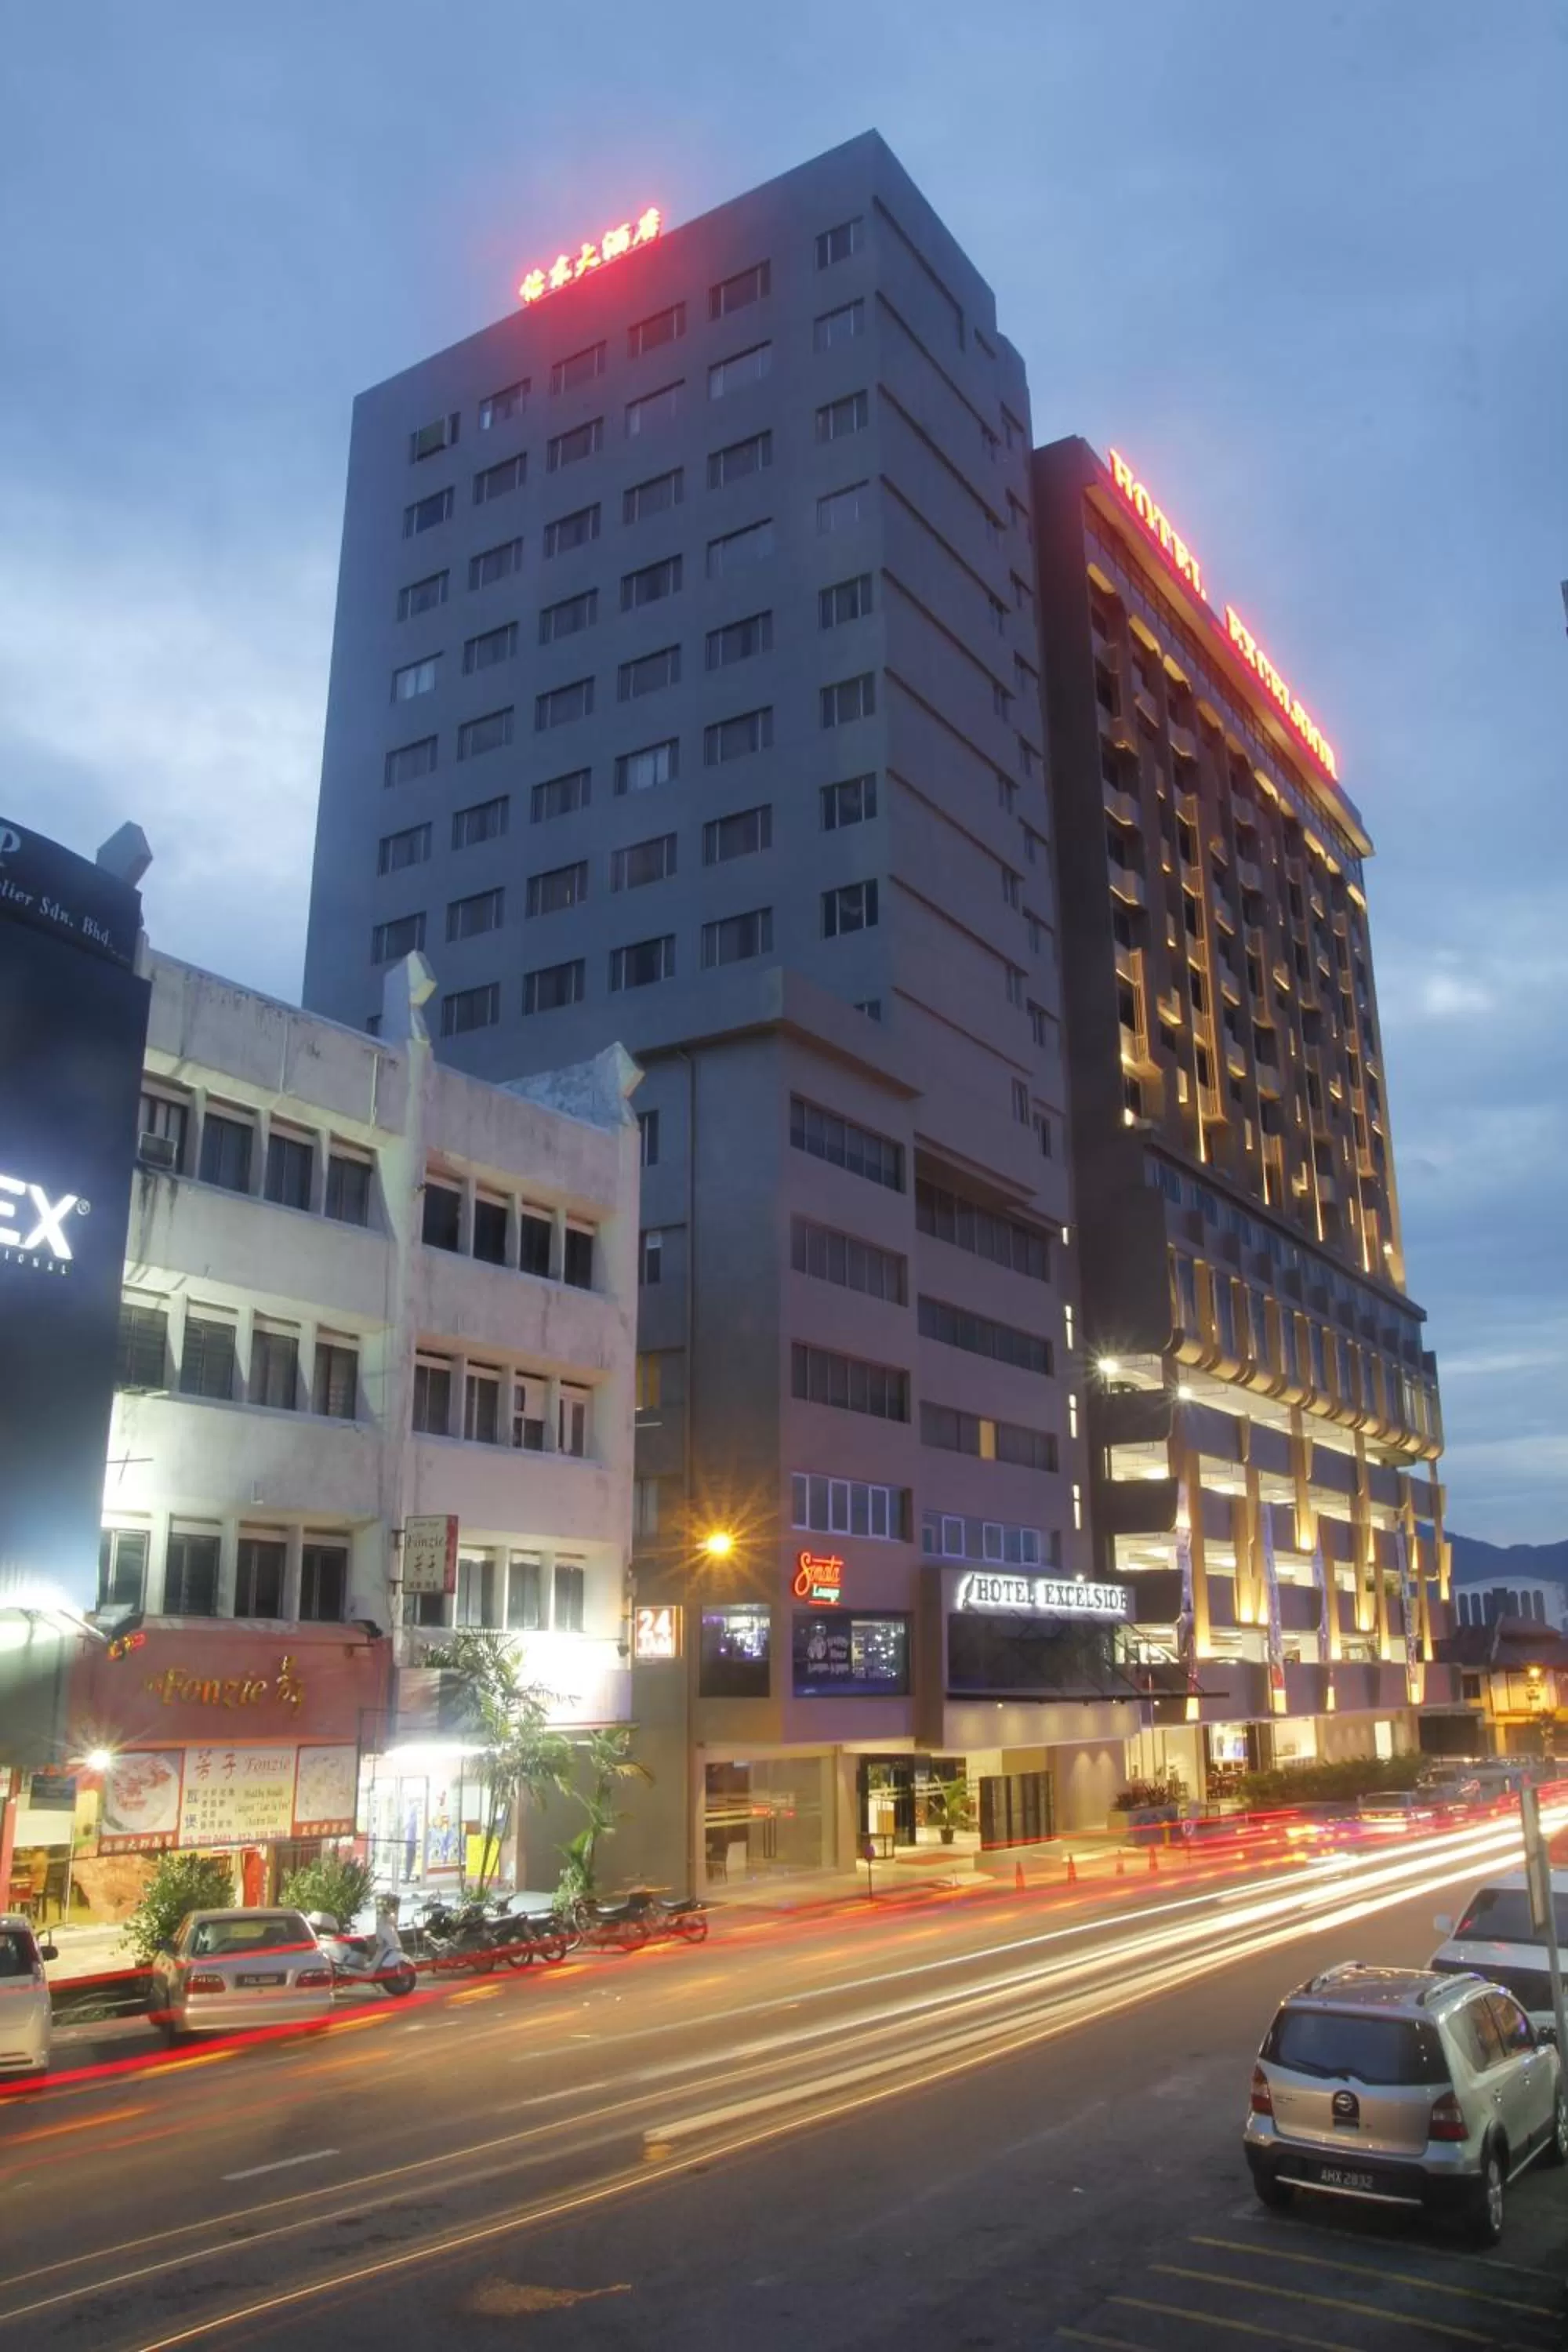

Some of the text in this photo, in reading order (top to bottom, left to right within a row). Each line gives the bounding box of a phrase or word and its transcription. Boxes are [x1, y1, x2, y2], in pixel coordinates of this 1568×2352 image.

[1109, 448, 1207, 601] HOTEL
[39, 896, 74, 927] Sdn.
[976, 1577, 1035, 1605] HOTEL
[638, 1609, 672, 1639] 24
[162, 1667, 268, 1709] Fonzie
